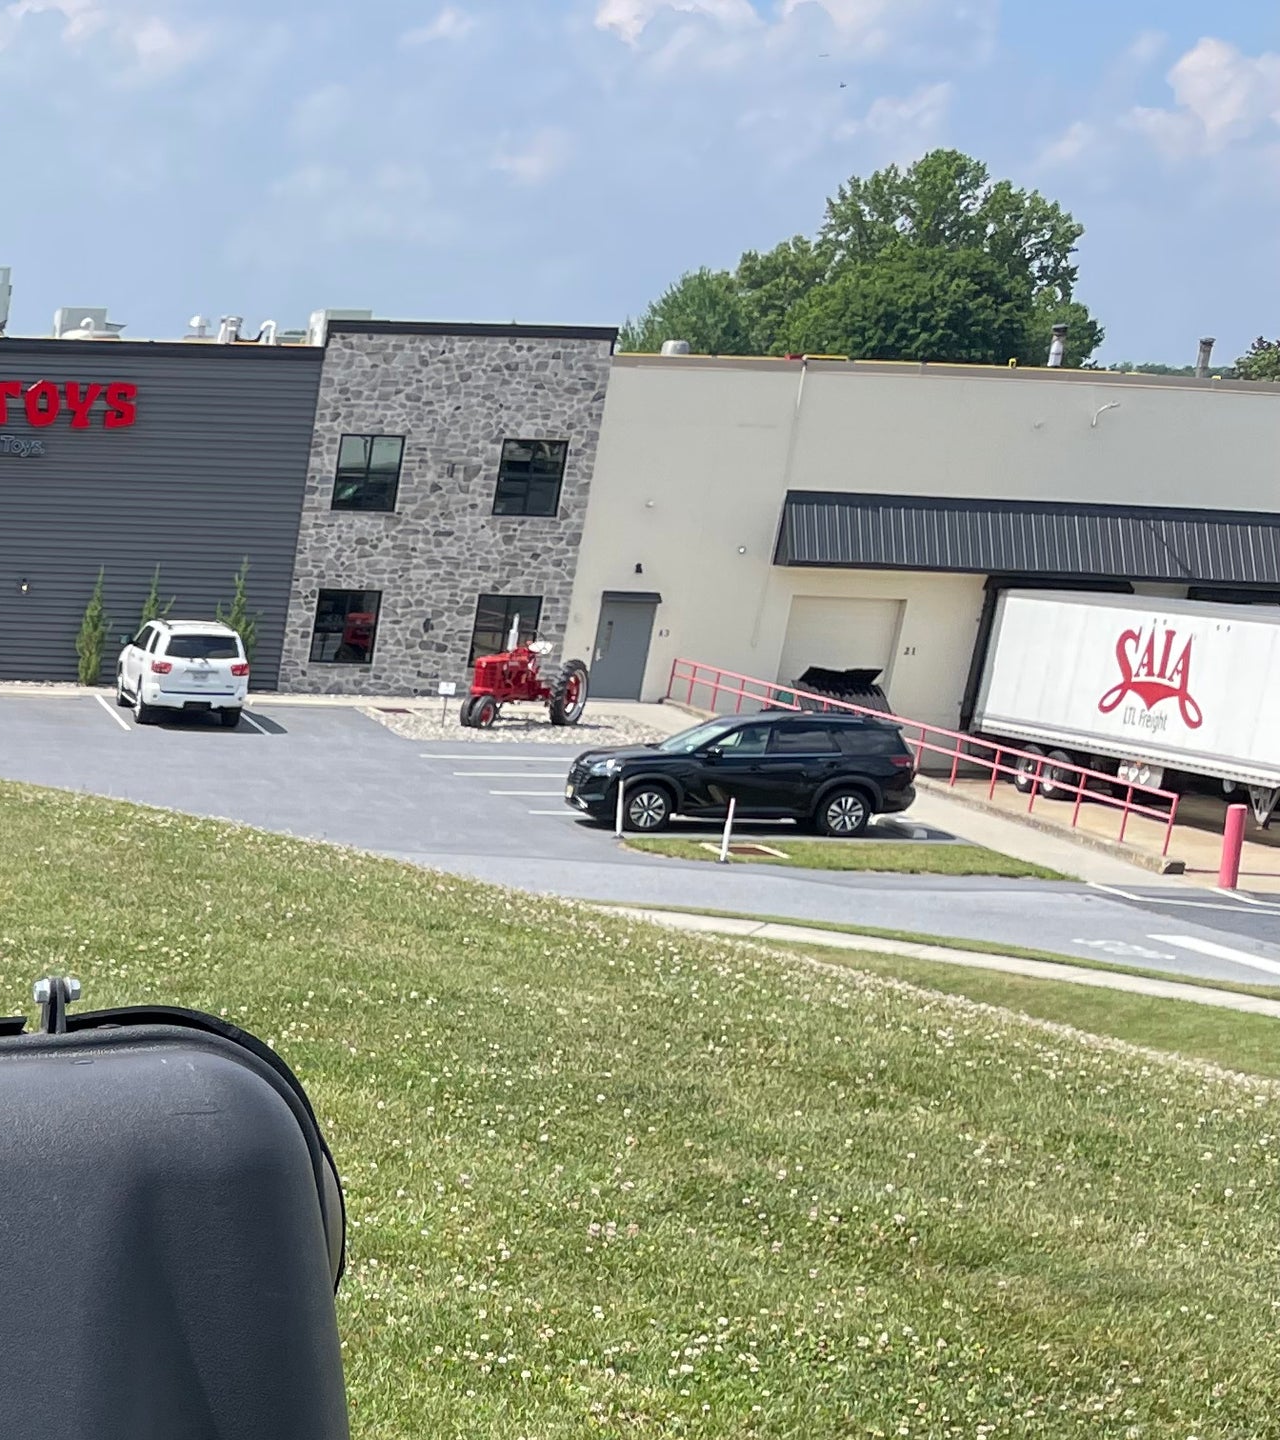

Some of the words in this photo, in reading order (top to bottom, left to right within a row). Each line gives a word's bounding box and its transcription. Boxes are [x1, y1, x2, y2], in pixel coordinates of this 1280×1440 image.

[0, 434, 45, 457] Toys.
[1100, 626, 1200, 710] SAIA
[1138, 709, 1168, 734] Freight
